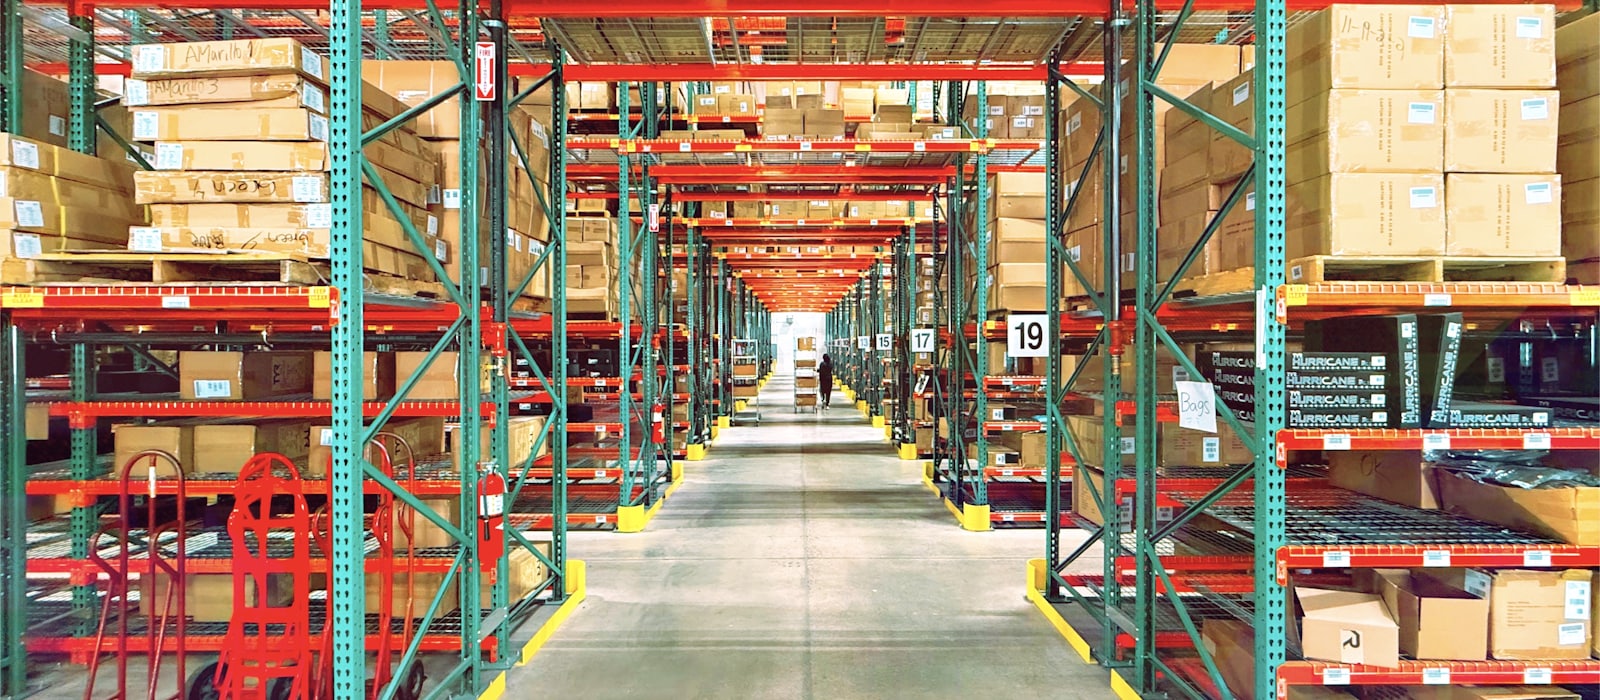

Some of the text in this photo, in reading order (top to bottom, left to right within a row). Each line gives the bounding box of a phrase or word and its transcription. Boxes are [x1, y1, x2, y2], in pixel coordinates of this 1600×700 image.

[914, 333, 930, 347] 17
[1014, 321, 1043, 350] 19
[878, 336, 890, 348] 15
[1212, 356, 1256, 368] HURRICAN
[1292, 356, 1360, 366] HURRICANE
[1214, 373, 1256, 385] HURRICAN
[1286, 375, 1356, 385] HURRICANE
[1404, 351, 1415, 423] HURRICANE
[1435, 351, 1454, 422] HURRICANE
[1180, 391, 1210, 417] Bags
[1290, 394, 1358, 404] HURRICANE
[1290, 414, 1360, 423] HURRICANE
[1450, 412, 1520, 423] HURRICANE
